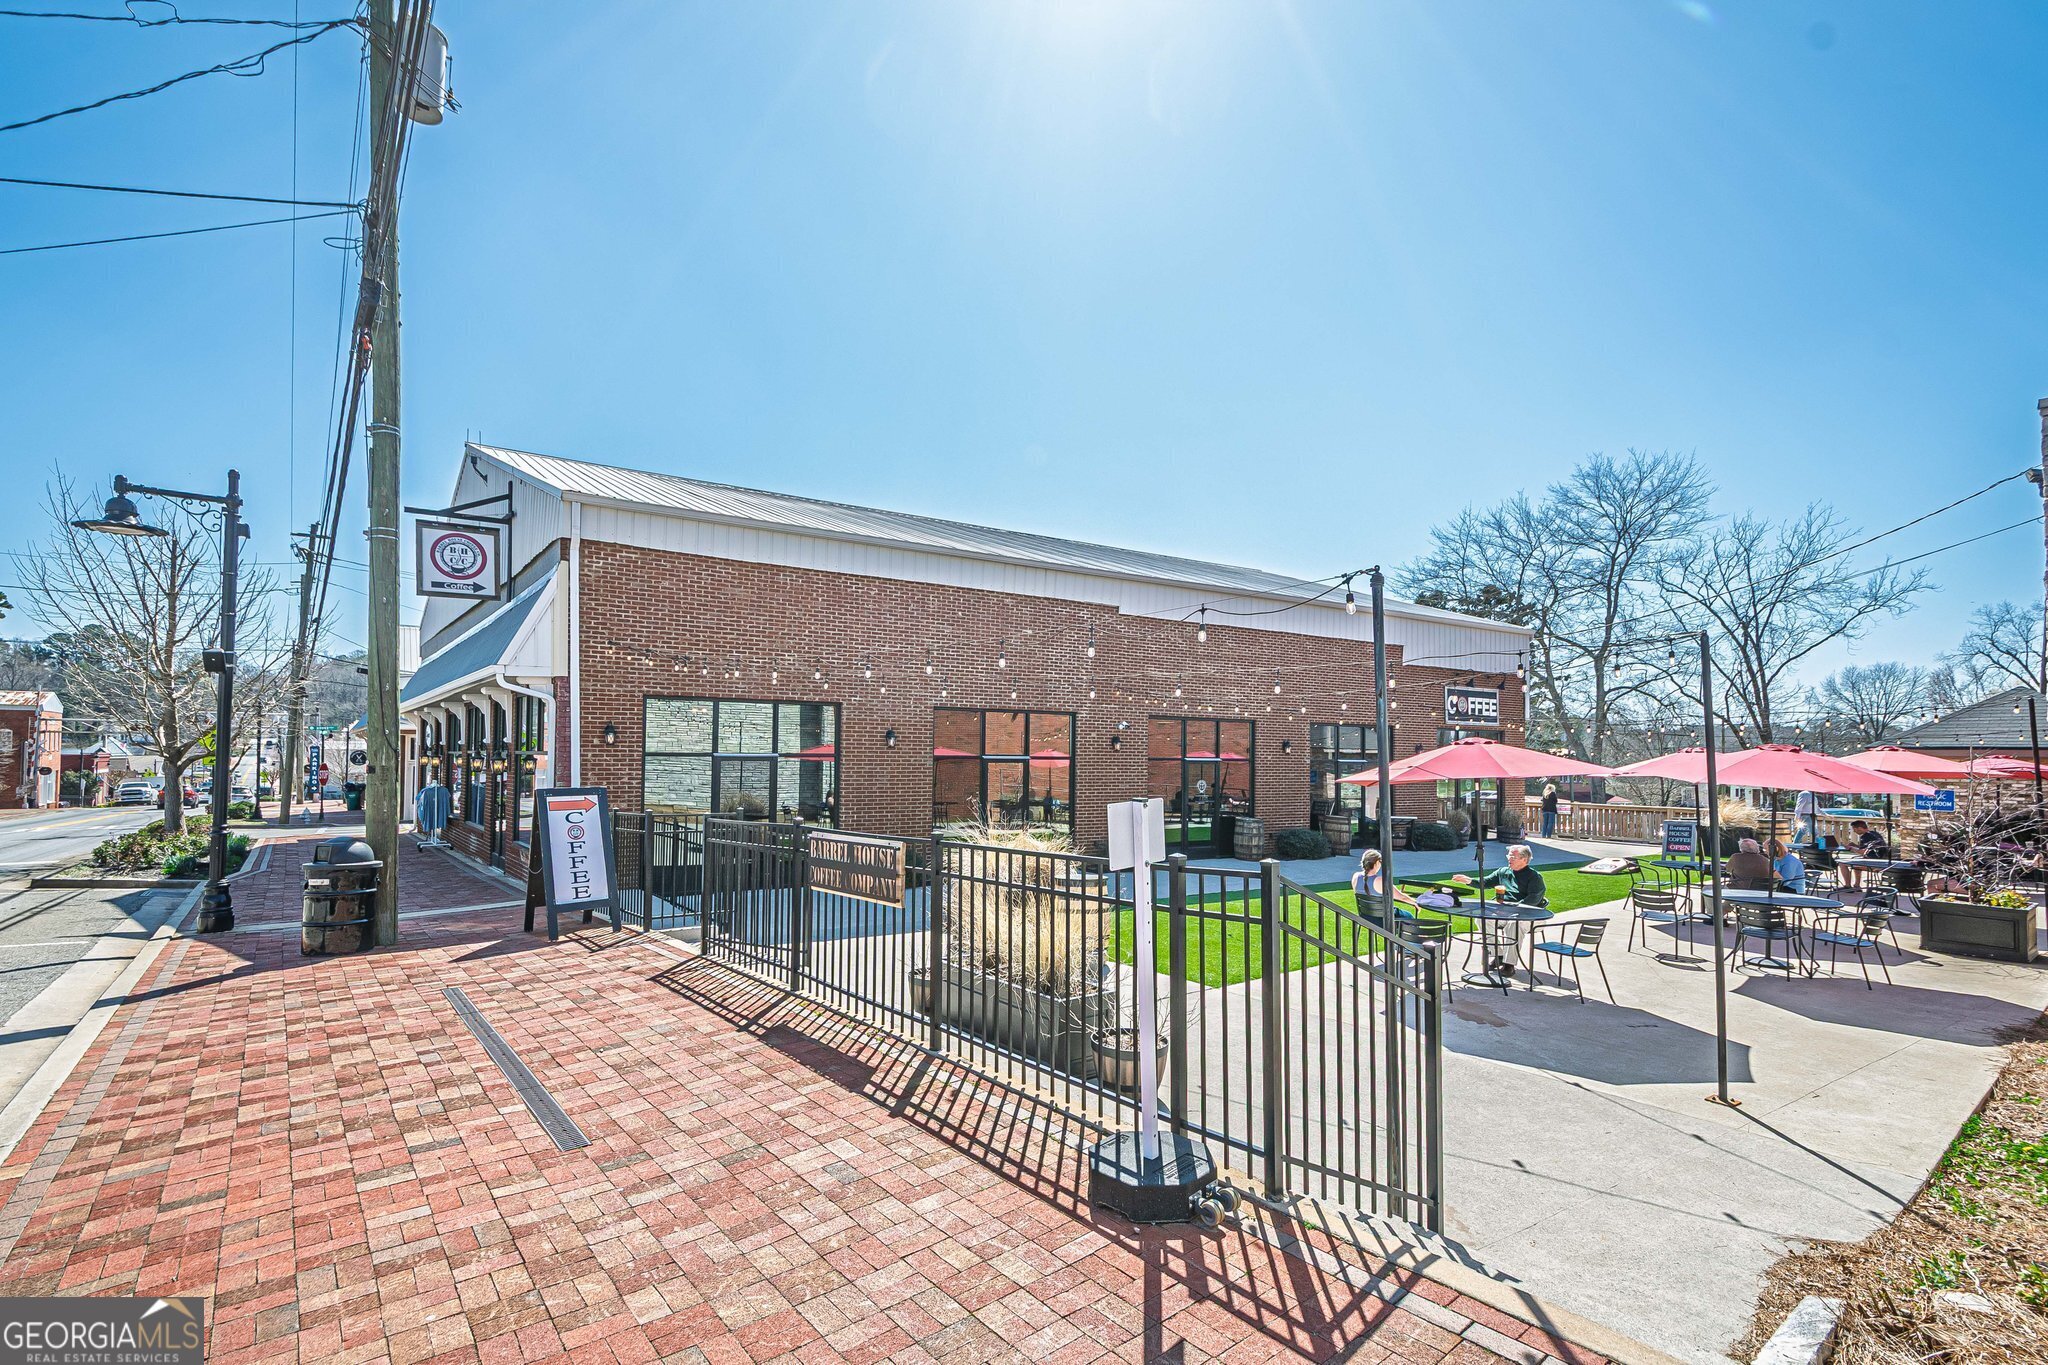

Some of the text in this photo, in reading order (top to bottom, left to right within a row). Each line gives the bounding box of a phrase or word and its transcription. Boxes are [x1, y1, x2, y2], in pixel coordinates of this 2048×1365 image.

[449, 546, 457, 554] B
[444, 582, 474, 591] Coffee
[1447, 695, 1497, 717] COFFEE
[565, 811, 592, 900] COFFEE
[810, 839, 894, 870] BARREL HOUSE
[809, 865, 842, 889] COFFEE
